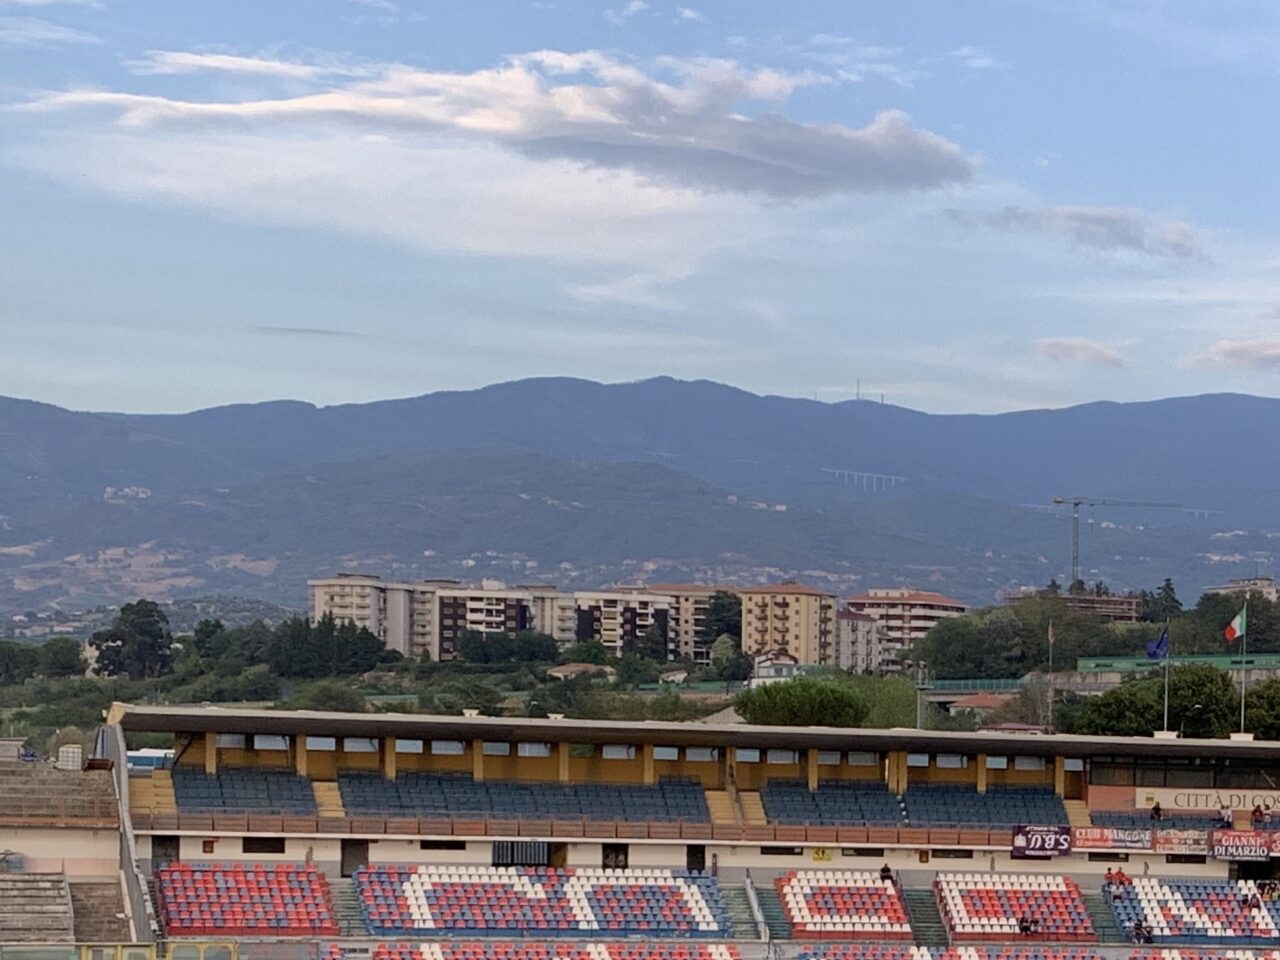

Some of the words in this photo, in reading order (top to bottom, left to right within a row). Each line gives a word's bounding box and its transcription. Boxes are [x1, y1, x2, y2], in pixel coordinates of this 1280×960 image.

[1174, 791, 1224, 808] CITTÀ
[1229, 794, 1247, 808] DI
[1222, 836, 1261, 846] GIANNI
[1214, 846, 1226, 856] DI
[1227, 846, 1268, 856] MARZIO
